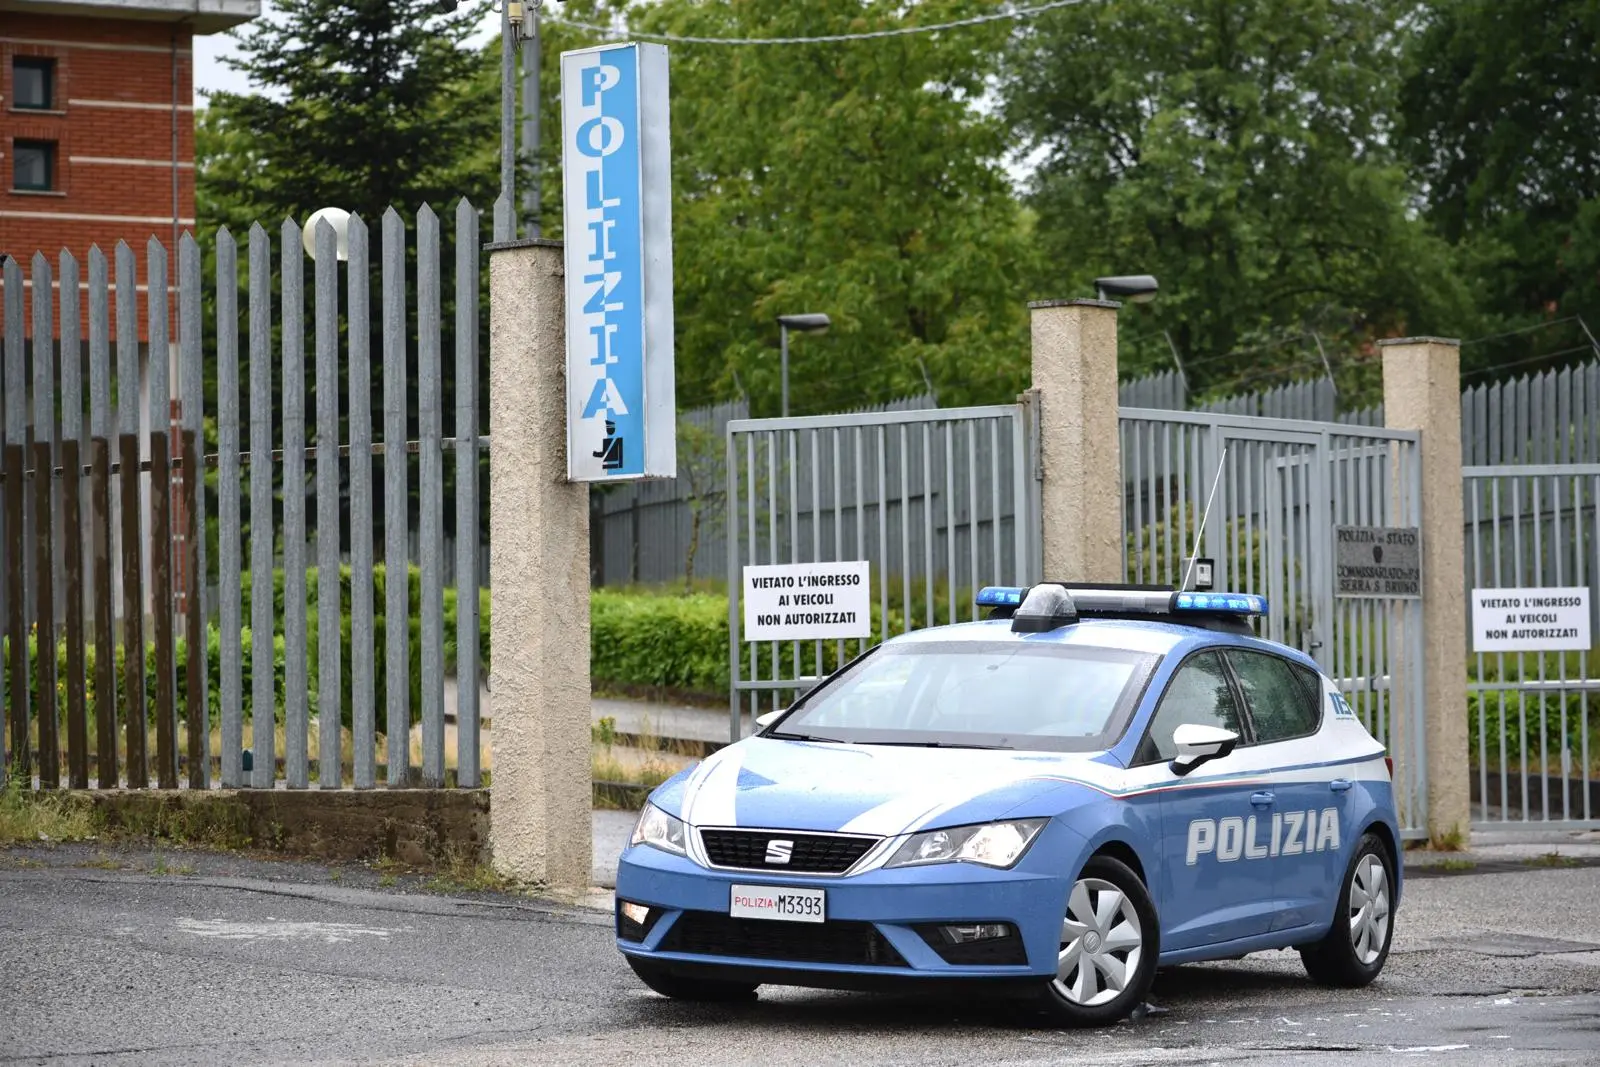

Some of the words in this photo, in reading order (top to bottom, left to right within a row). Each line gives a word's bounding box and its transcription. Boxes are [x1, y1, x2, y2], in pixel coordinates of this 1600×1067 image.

[576, 64, 629, 418] POLIZIA
[1338, 530, 1376, 543] POLIZIA
[1386, 532, 1416, 545] STATO
[752, 576, 795, 589] VIETATO
[798, 574, 860, 587] L'INGRESSO
[1340, 580, 1371, 592] SERRA
[1385, 581, 1418, 593] BRUNO
[778, 595, 790, 606] AI
[793, 593, 834, 606] VEICOLI
[1481, 598, 1521, 608] VIETATO
[1524, 597, 1581, 607] L'INGRESSO
[757, 614, 781, 626] NON
[784, 612, 856, 625] AUTORIZZATI
[1506, 614, 1516, 624] AI
[1519, 613, 1557, 624] VEICOLI
[1485, 629, 1508, 639] NON
[1511, 628, 1578, 638] AUTORIZZATI
[1185, 807, 1340, 866] POLIZIA
[734, 896, 774, 909] POLIZIA
[777, 895, 822, 916] M3393
